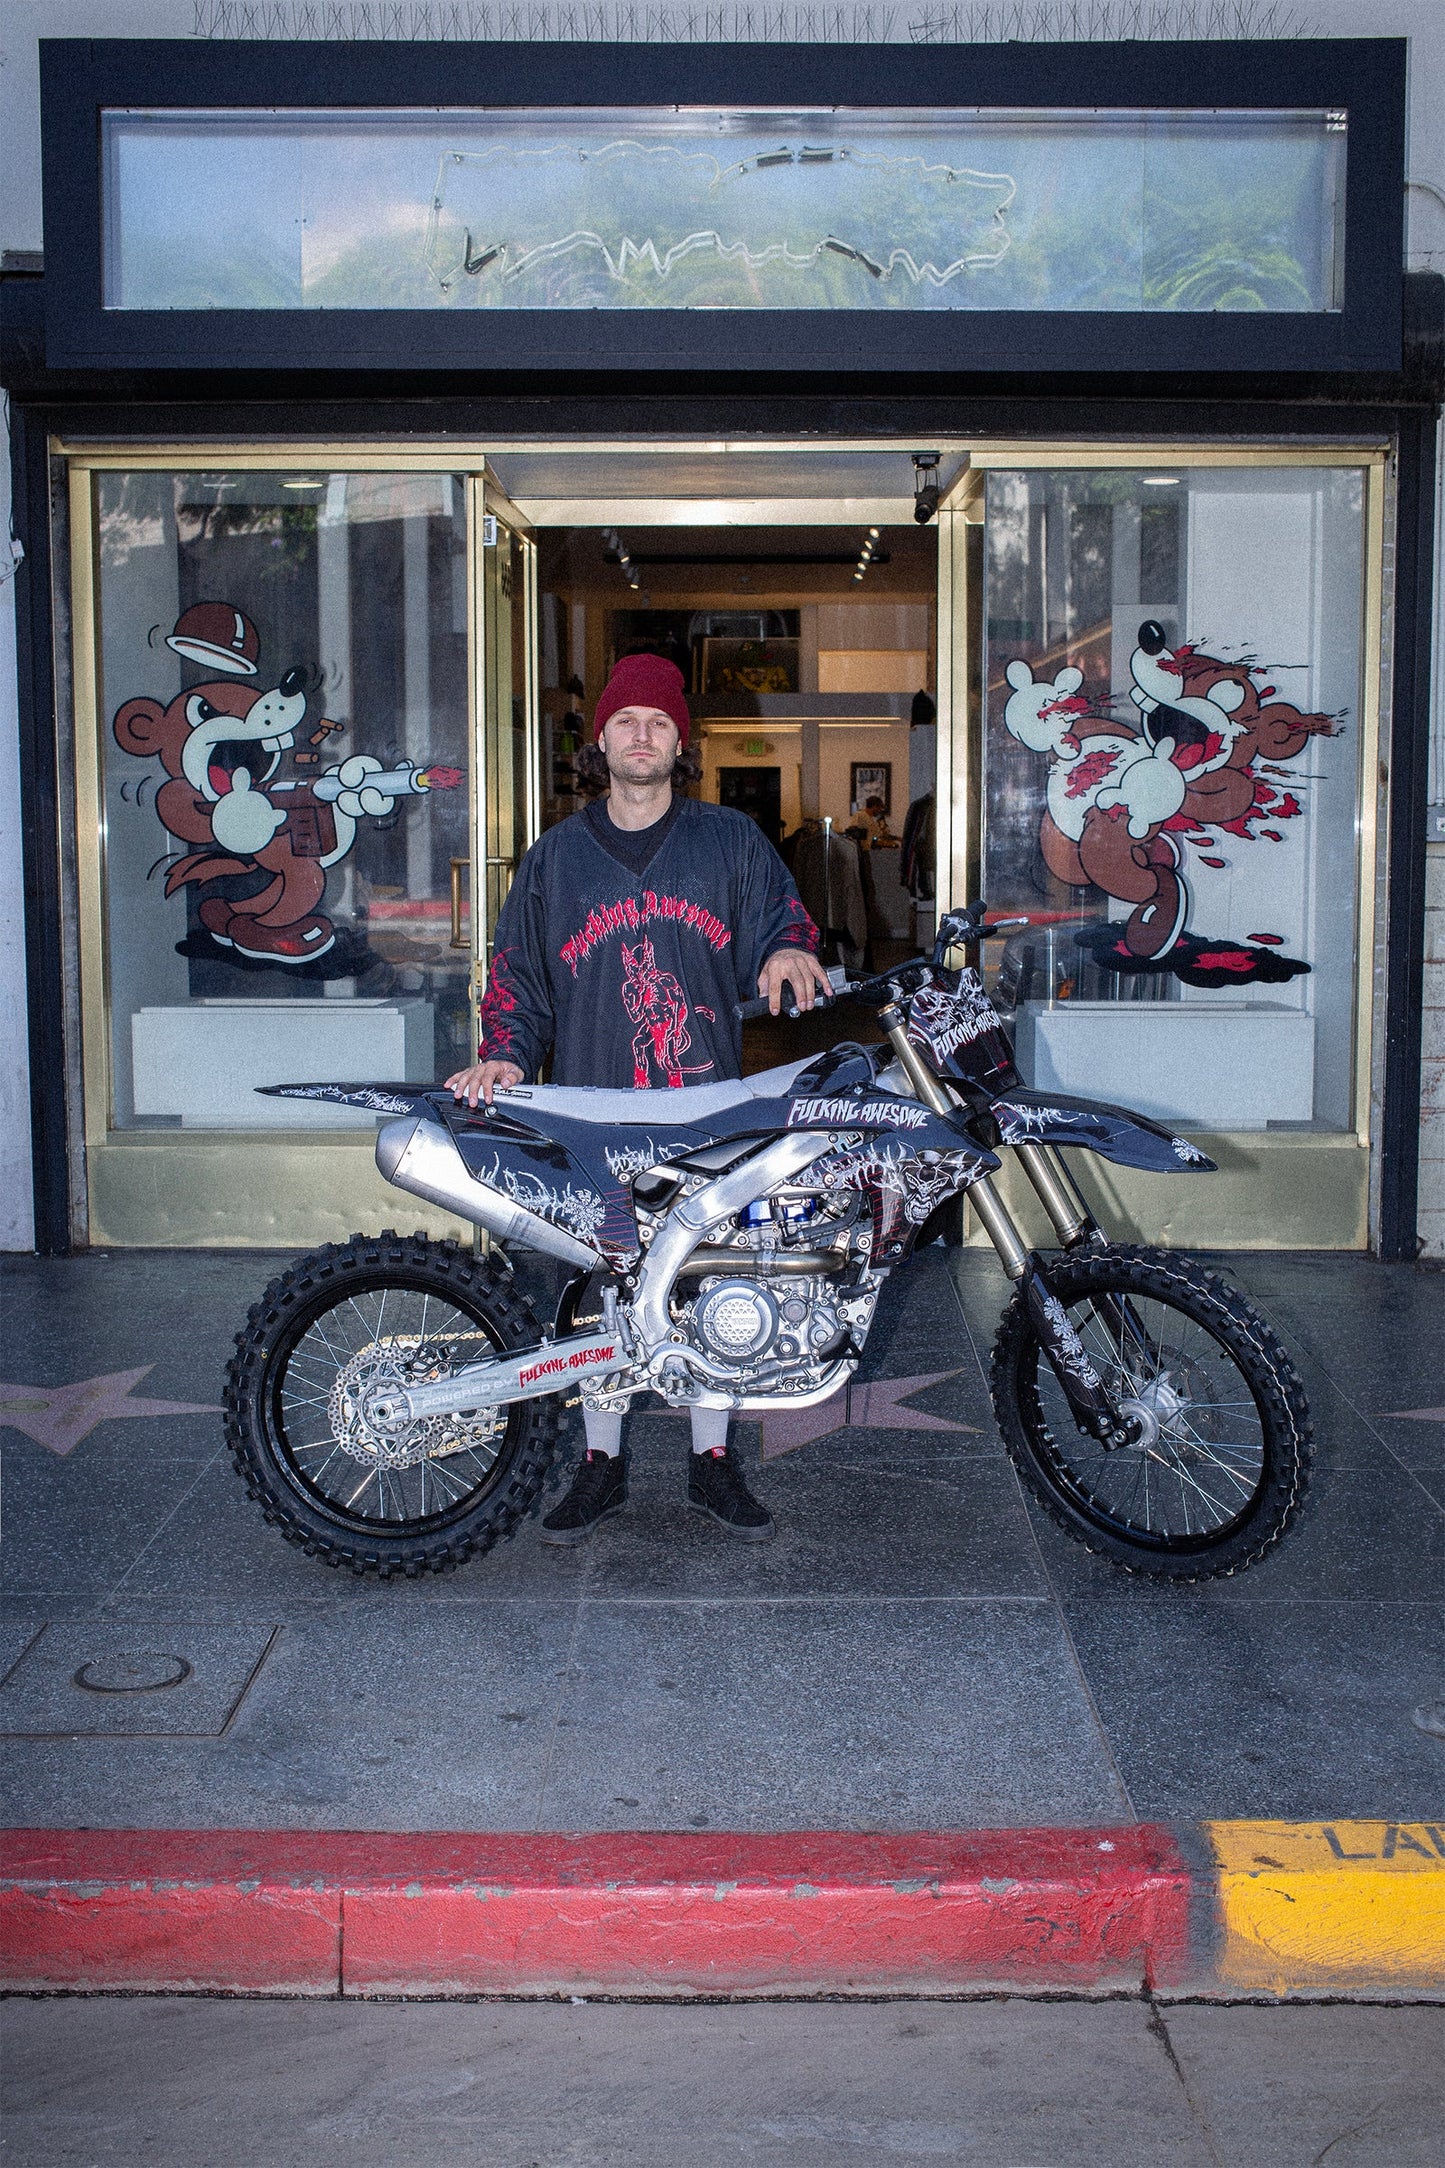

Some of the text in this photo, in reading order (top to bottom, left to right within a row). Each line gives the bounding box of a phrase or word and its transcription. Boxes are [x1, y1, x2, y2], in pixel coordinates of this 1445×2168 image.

[559, 889, 732, 978] Fucking Awesome
[931, 1020, 979, 1066] FUCKING
[786, 1098, 932, 1130] FUCKING AWESOME
[422, 1345, 617, 1409] POWERED BY FUCKING AWESOME
